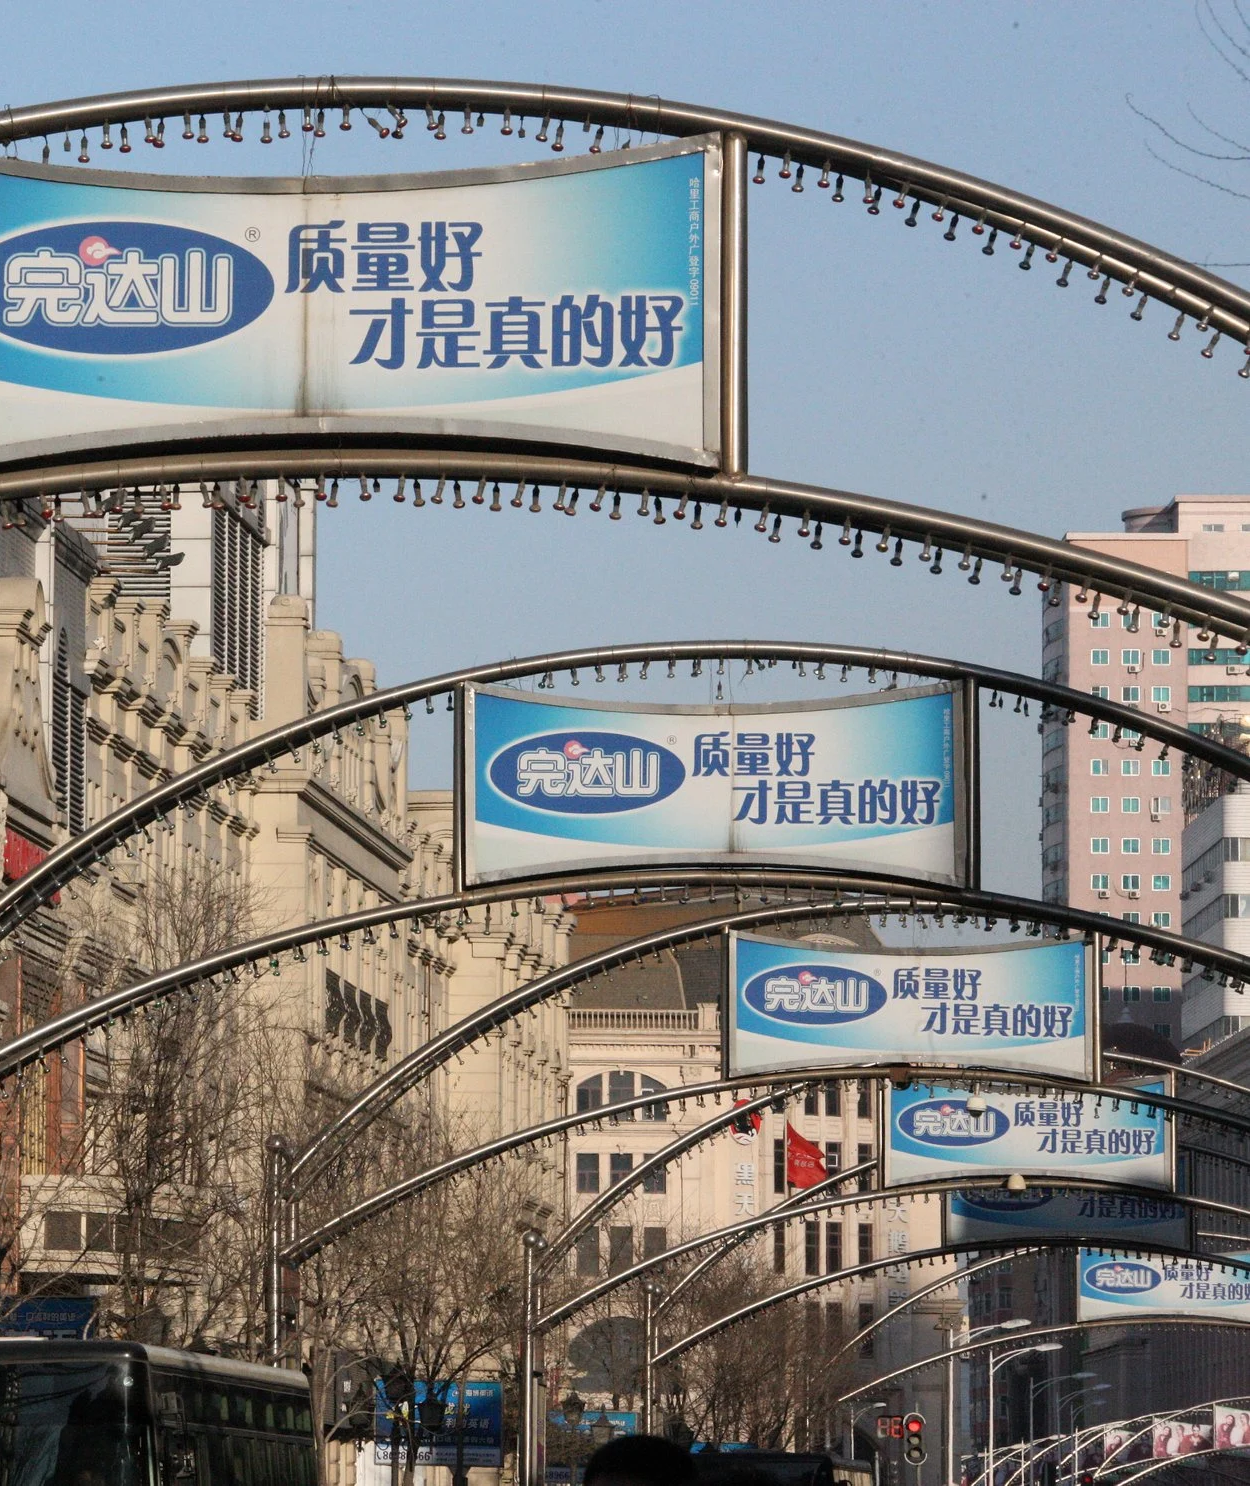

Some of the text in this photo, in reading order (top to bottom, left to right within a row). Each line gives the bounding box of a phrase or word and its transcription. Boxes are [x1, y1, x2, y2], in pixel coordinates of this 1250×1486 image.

[285, 219, 484, 295] 质量好
[3, 246, 235, 328] 完达山
[349, 293, 684, 370] 才是真的好
[516, 746, 661, 799] 完达山
[692, 731, 816, 779] 质量好
[733, 778, 940, 827] 才是真的好
[763, 975, 871, 1015] 完达山
[892, 967, 983, 1001] 质量好
[921, 1002, 1075, 1040] 才是真的好
[912, 1106, 998, 1139] 完达山
[1013, 1101, 1083, 1128] 质量好
[1036, 1129, 1156, 1157] 才是真的好
[1095, 1268, 1152, 1289] 完达山
[1164, 1264, 1211, 1281] 质量好
